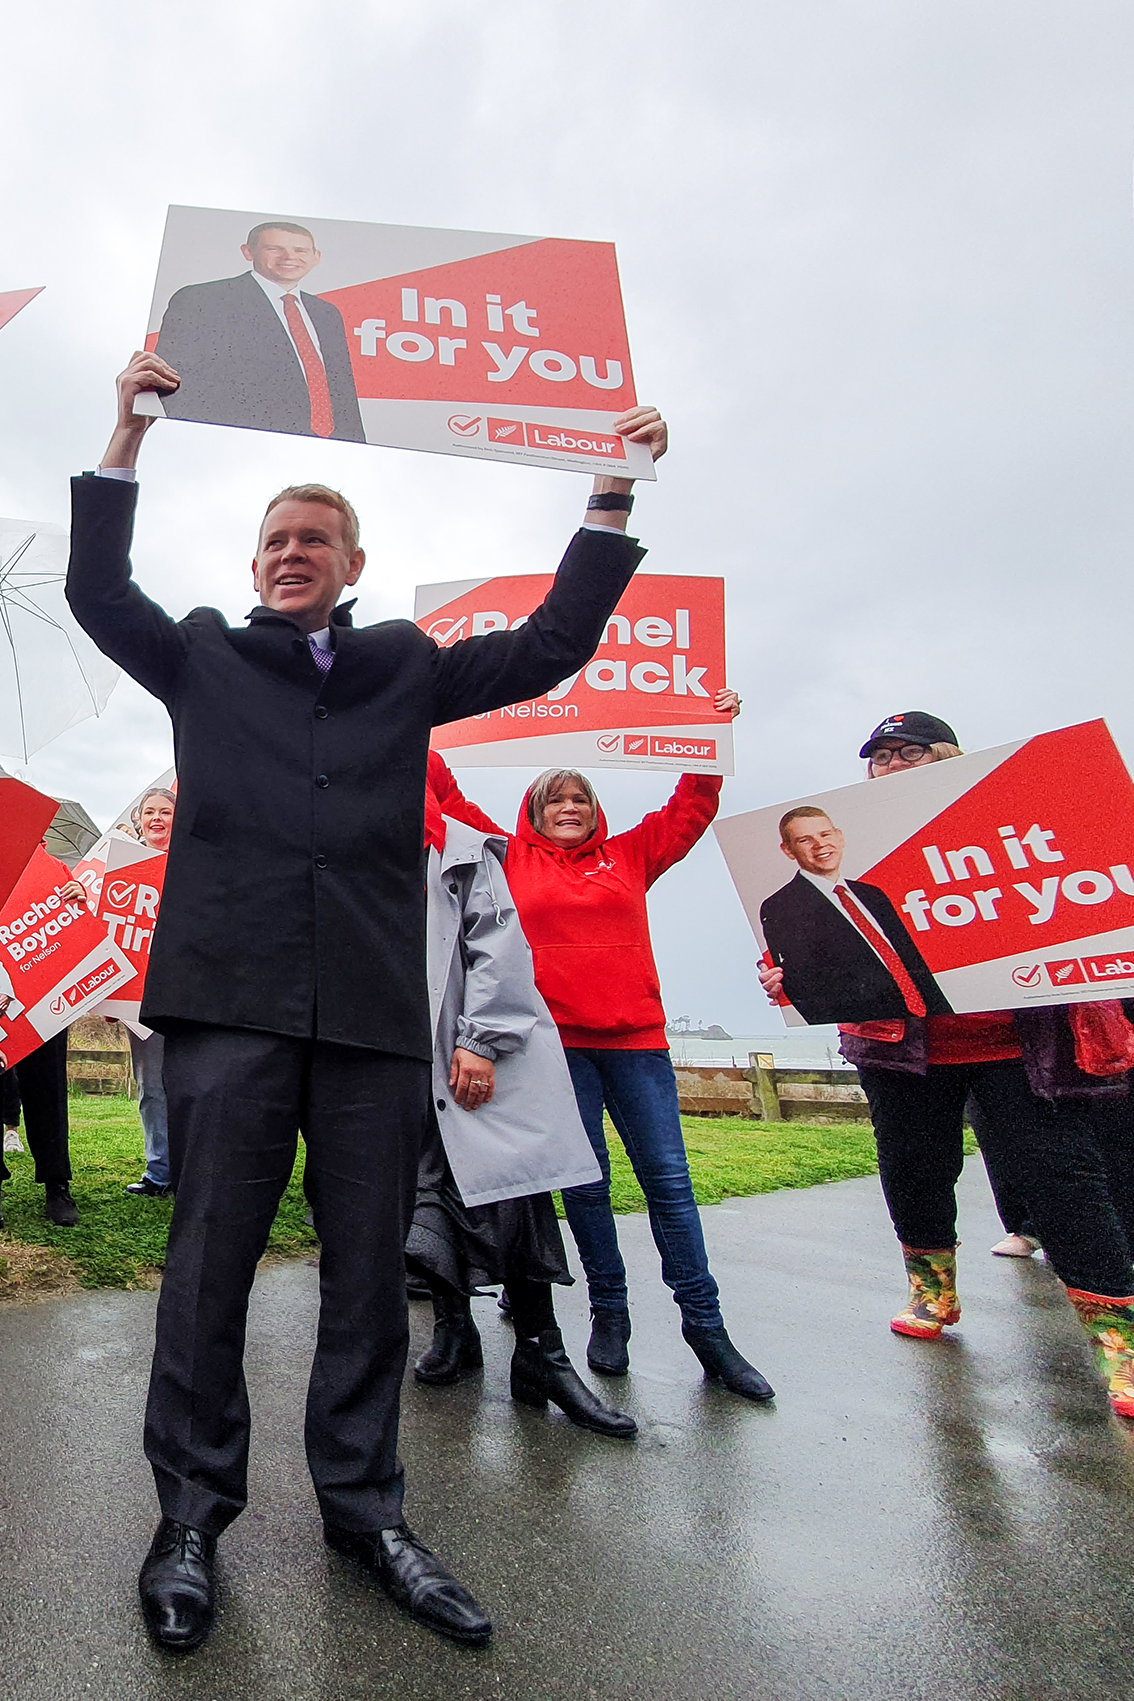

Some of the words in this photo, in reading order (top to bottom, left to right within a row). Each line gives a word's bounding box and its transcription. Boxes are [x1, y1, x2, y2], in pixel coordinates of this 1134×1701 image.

[401, 287, 467, 328] In
[485, 293, 539, 337] it
[353, 318, 467, 366] for
[481, 341, 624, 389] you
[533, 429, 615, 453] Labour
[500, 701, 579, 718] Nelson
[655, 740, 711, 755] Labour
[922, 845, 995, 884] In
[997, 823, 1065, 870] it
[901, 888, 1003, 931] for
[6, 903, 86, 962] Boyack
[19, 961, 33, 973] for
[31, 941, 62, 964] Nelson
[81, 964, 115, 992] Labour
